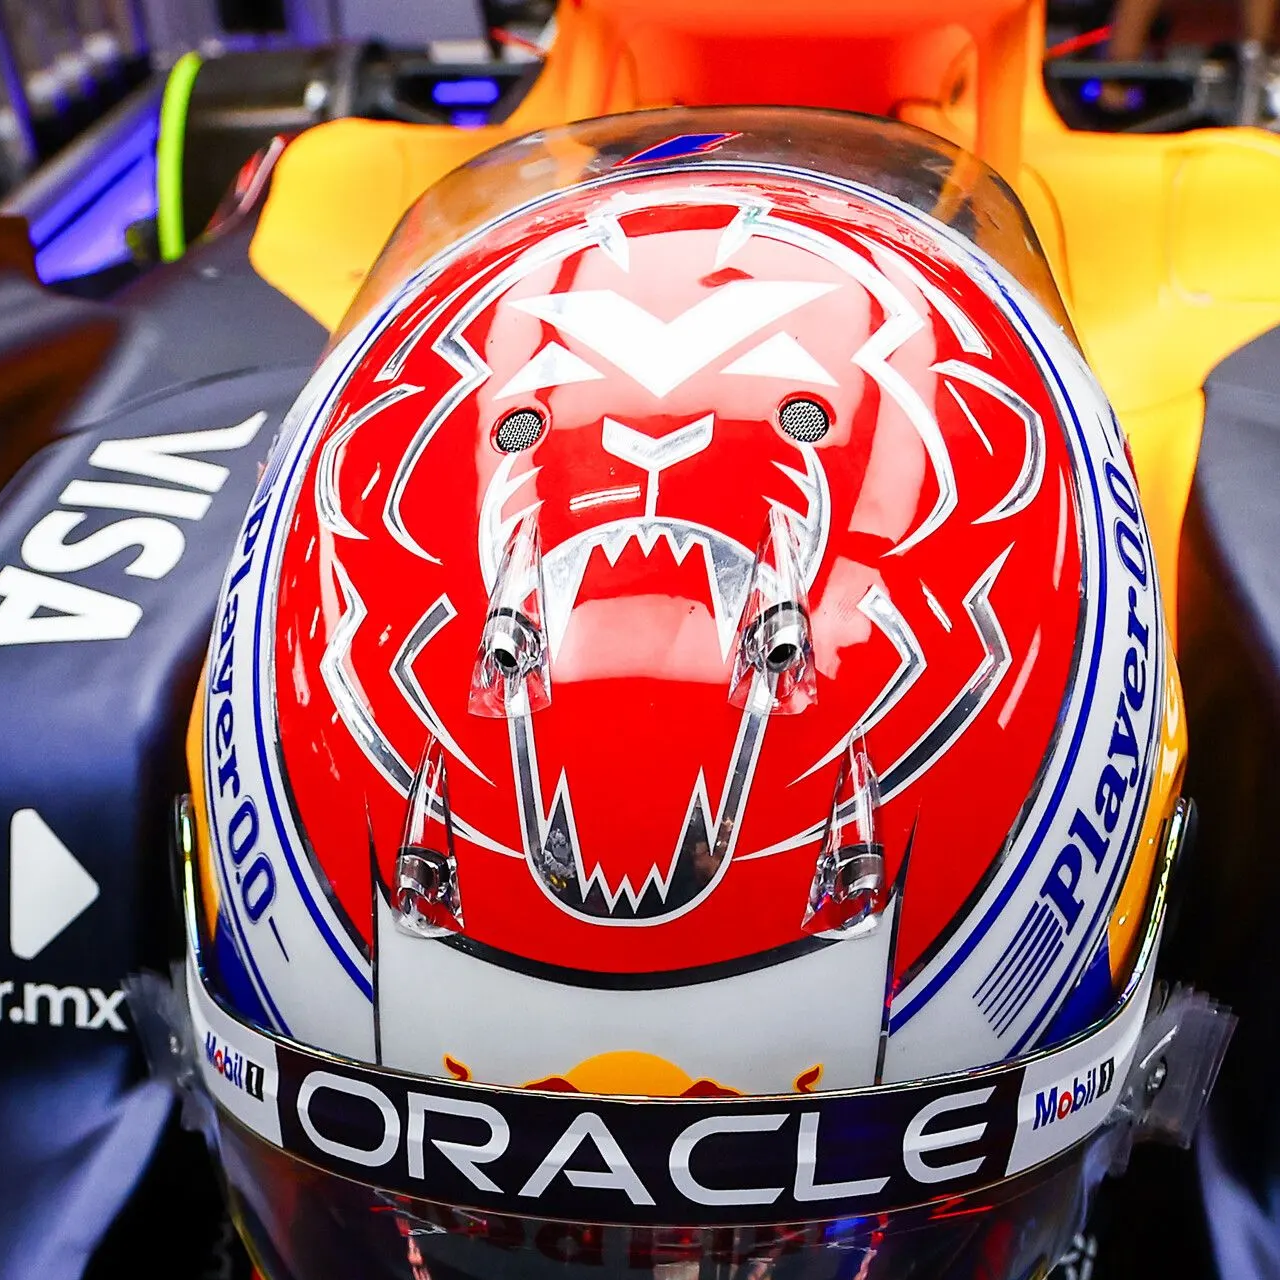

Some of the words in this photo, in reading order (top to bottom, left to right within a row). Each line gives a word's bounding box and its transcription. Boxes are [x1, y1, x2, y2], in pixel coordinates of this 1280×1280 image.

[205, 1031, 243, 1090] Mobil
[1032, 1067, 1097, 1131] Mobil
[296, 1086, 997, 1206] ORACLE
